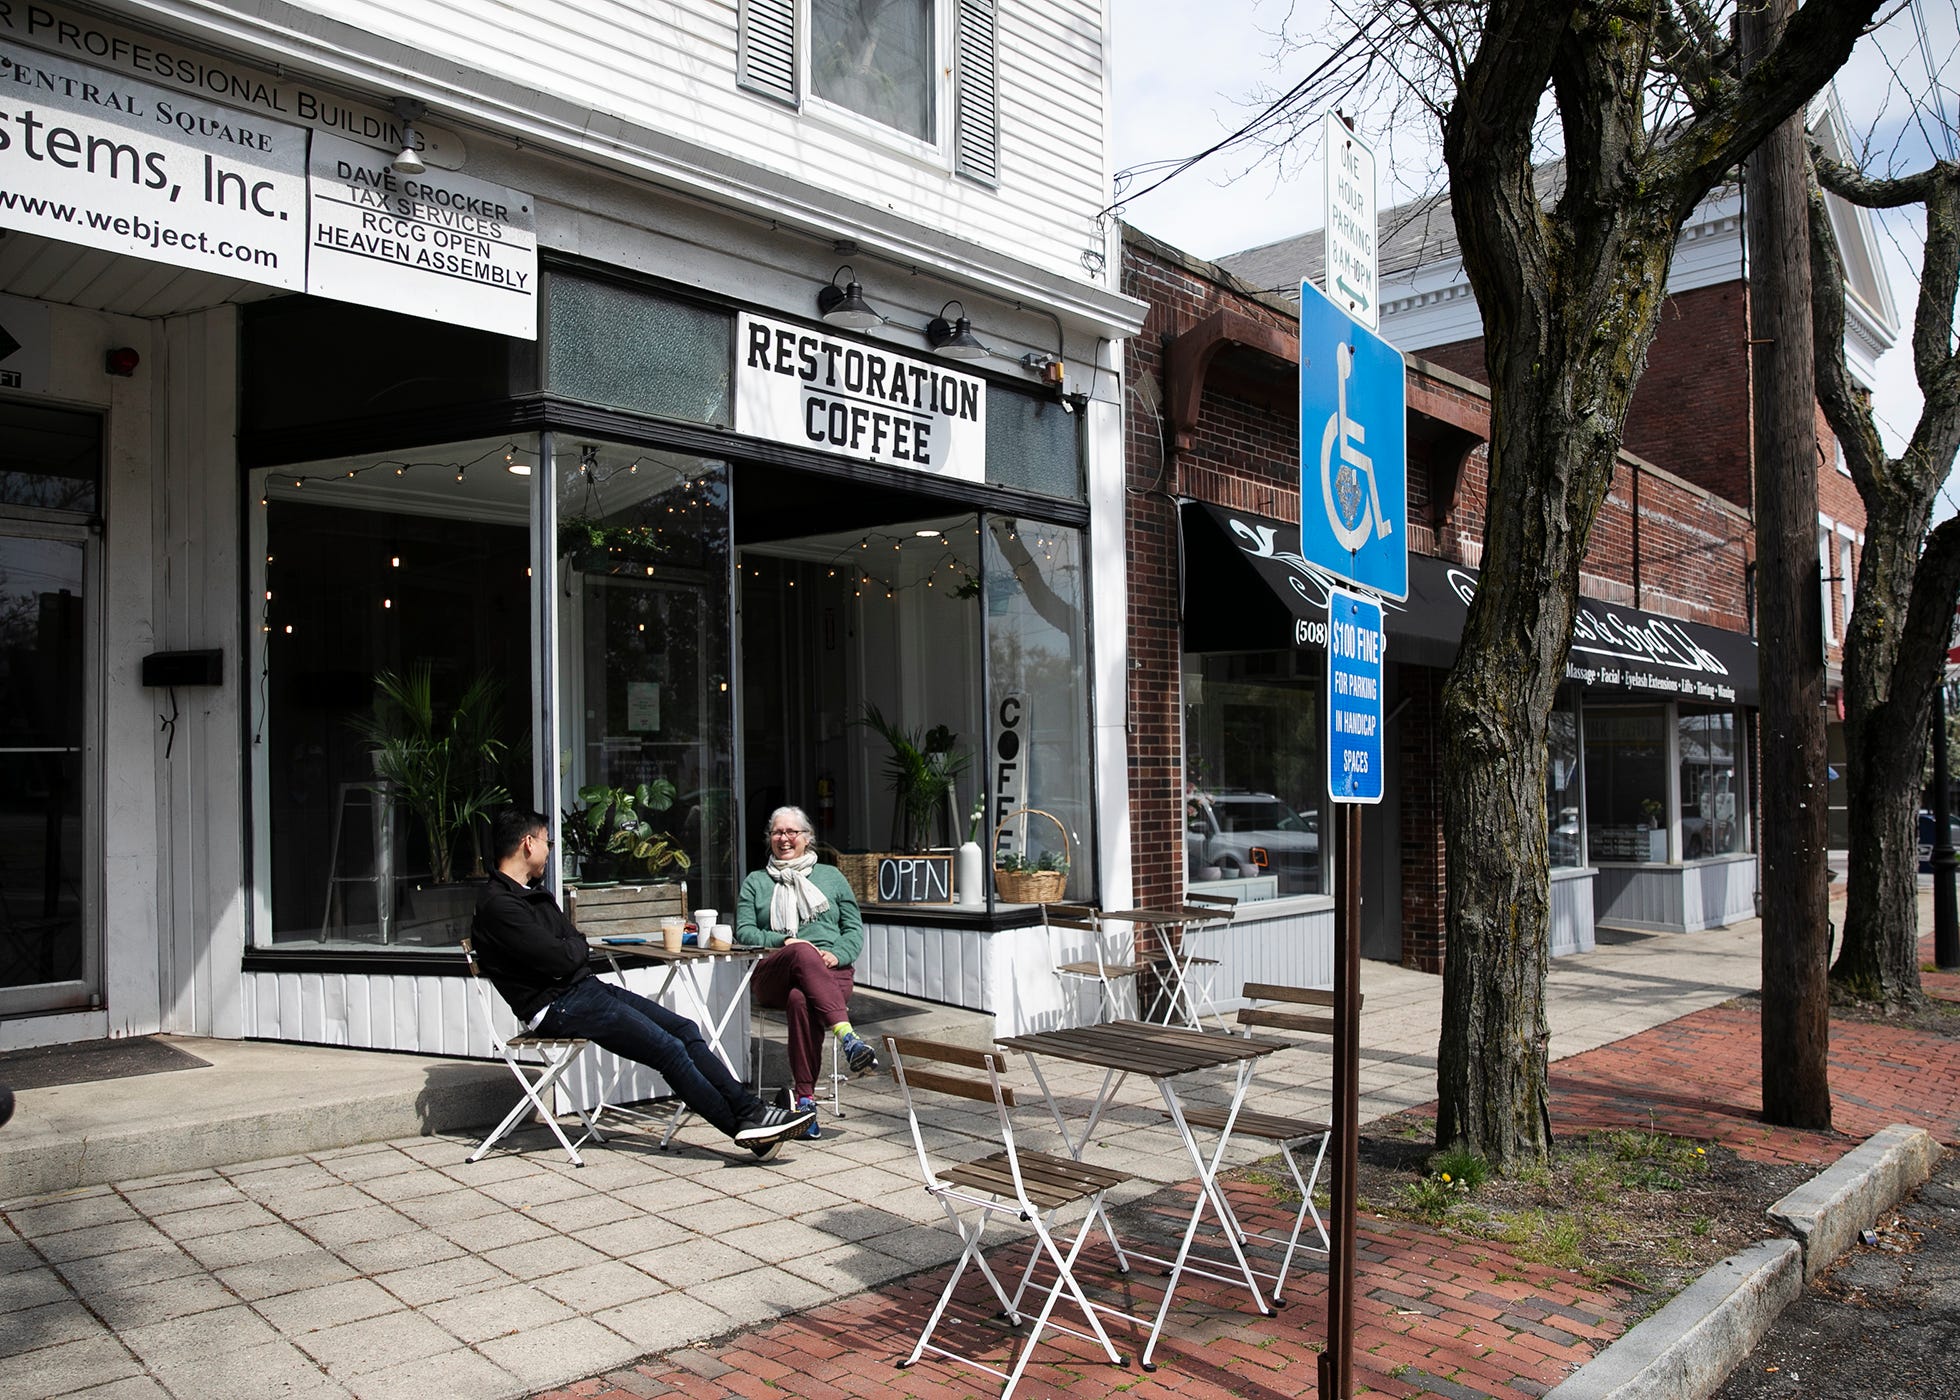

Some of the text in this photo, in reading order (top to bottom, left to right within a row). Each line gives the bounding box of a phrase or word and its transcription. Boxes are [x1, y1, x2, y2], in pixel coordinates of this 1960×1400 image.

[28, 5, 288, 113] PROFESSIONAL
[297, 91, 425, 152] BUILDING
[157, 102, 273, 153] SQUARE
[1341, 144, 1360, 181] ONE
[204, 154, 288, 221] Inc.
[337, 160, 509, 223] DAVE CROCKER
[346, 184, 502, 239] TAX SERVICES
[1338, 174, 1364, 218] HOUR
[0, 190, 278, 269] www.webject.com
[362, 211, 490, 259] RCCG OPEN
[1332, 204, 1371, 257] PARKING
[318, 223, 529, 289] HEAVEN ASSEMBLY
[747, 321, 979, 423] RESTORATION
[805, 396, 931, 466] COFFEE
[1295, 618, 1328, 649] (508)
[1333, 617, 1356, 659] $100
[1357, 626, 1379, 665] FINE
[1334, 670, 1377, 700] FOR PARKING
[1566, 661, 1596, 686] Massage
[1601, 666, 1620, 684] Facial
[1625, 670, 1648, 690] Eyelash
[1648, 673, 1678, 692] Extensions
[1335, 709, 1376, 737] IN HANDICAP
[1343, 749, 1369, 774] SPACES
[879, 858, 949, 902] OPEN
